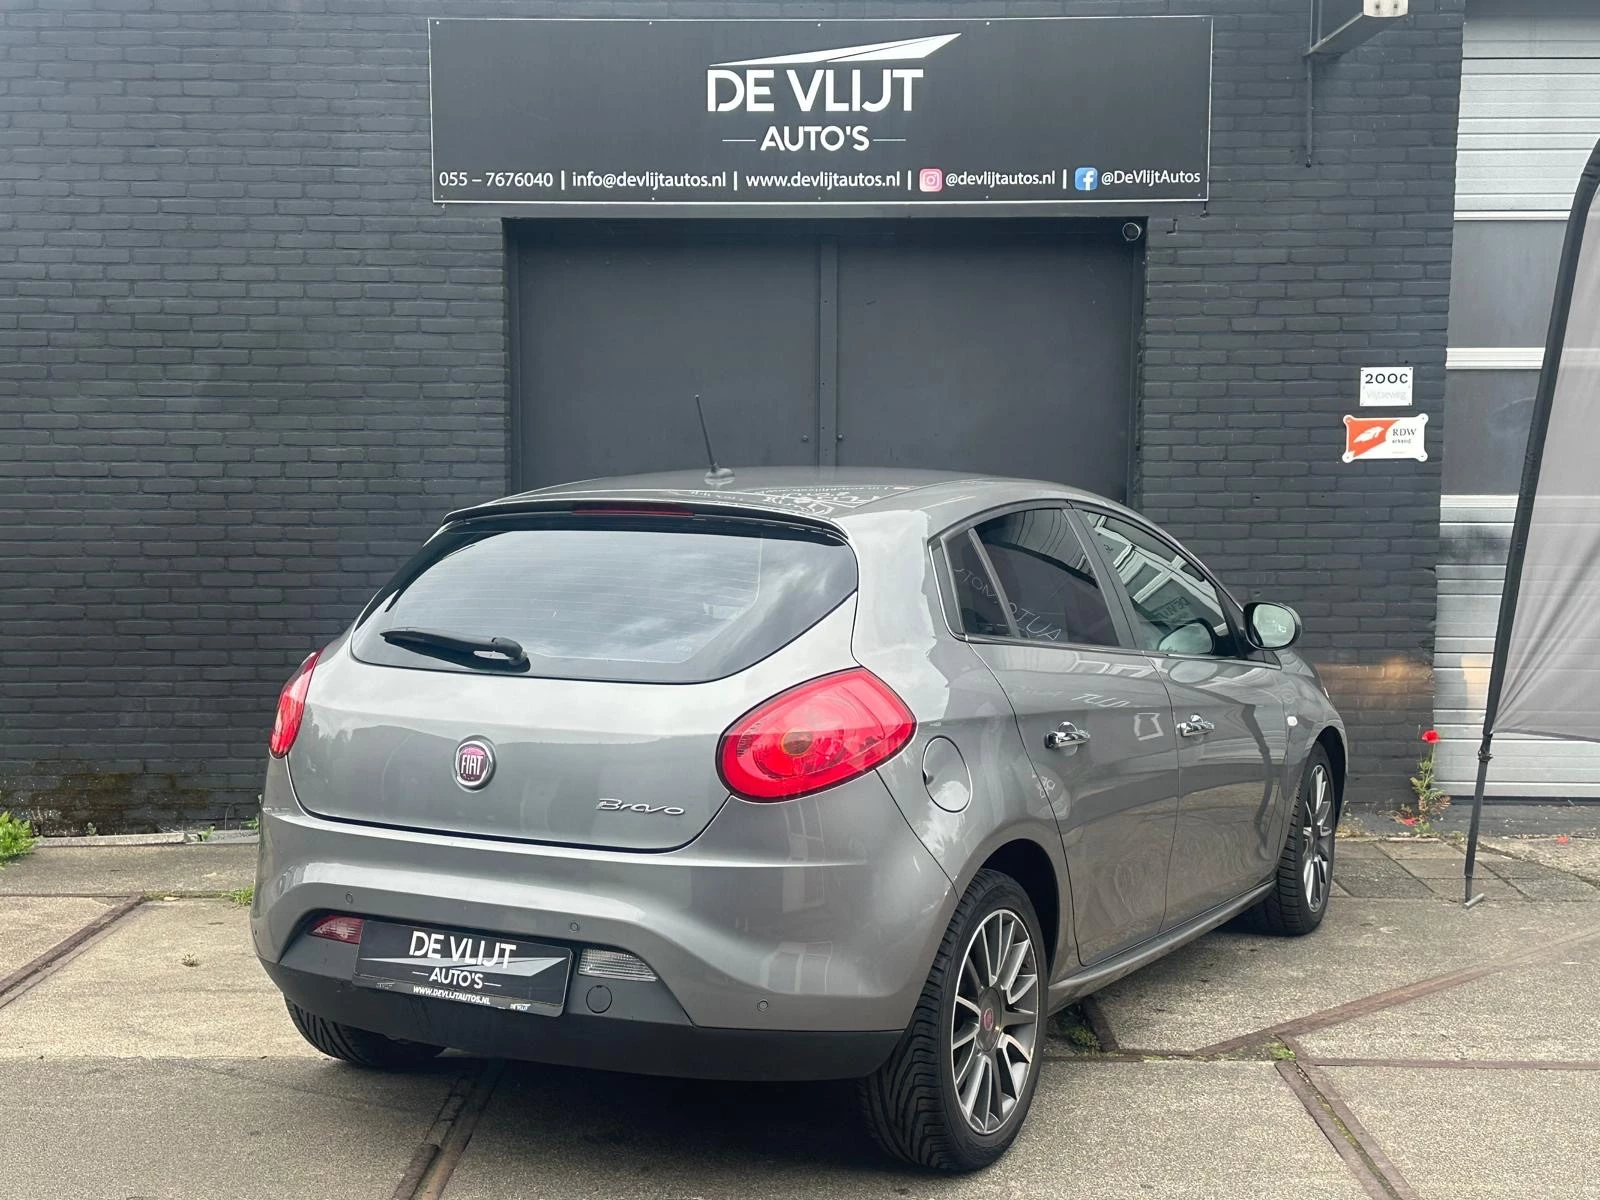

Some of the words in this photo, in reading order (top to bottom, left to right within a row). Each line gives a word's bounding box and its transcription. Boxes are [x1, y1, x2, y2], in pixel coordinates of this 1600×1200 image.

[707, 69, 775, 112] DE
[786, 68, 925, 113] VLIJT
[759, 124, 870, 152] AUTO'S
[438, 171, 468, 187] 055
[485, 171, 554, 188] 7676040
[572, 170, 727, 191] info@devlijtautos.nl
[745, 170, 901, 191] www.devlijtautos.nl
[945, 169, 1056, 189] @devlijtautos.nl
[1101, 169, 1201, 187] @DeVlijtAutos
[1392, 428, 1417, 437] RDW
[460, 754, 484, 776] FIAT
[595, 798, 685, 816] Bravo
[409, 930, 444, 959] DE
[450, 935, 517, 969] VLIJT
[428, 967, 484, 989] AUTO'S
